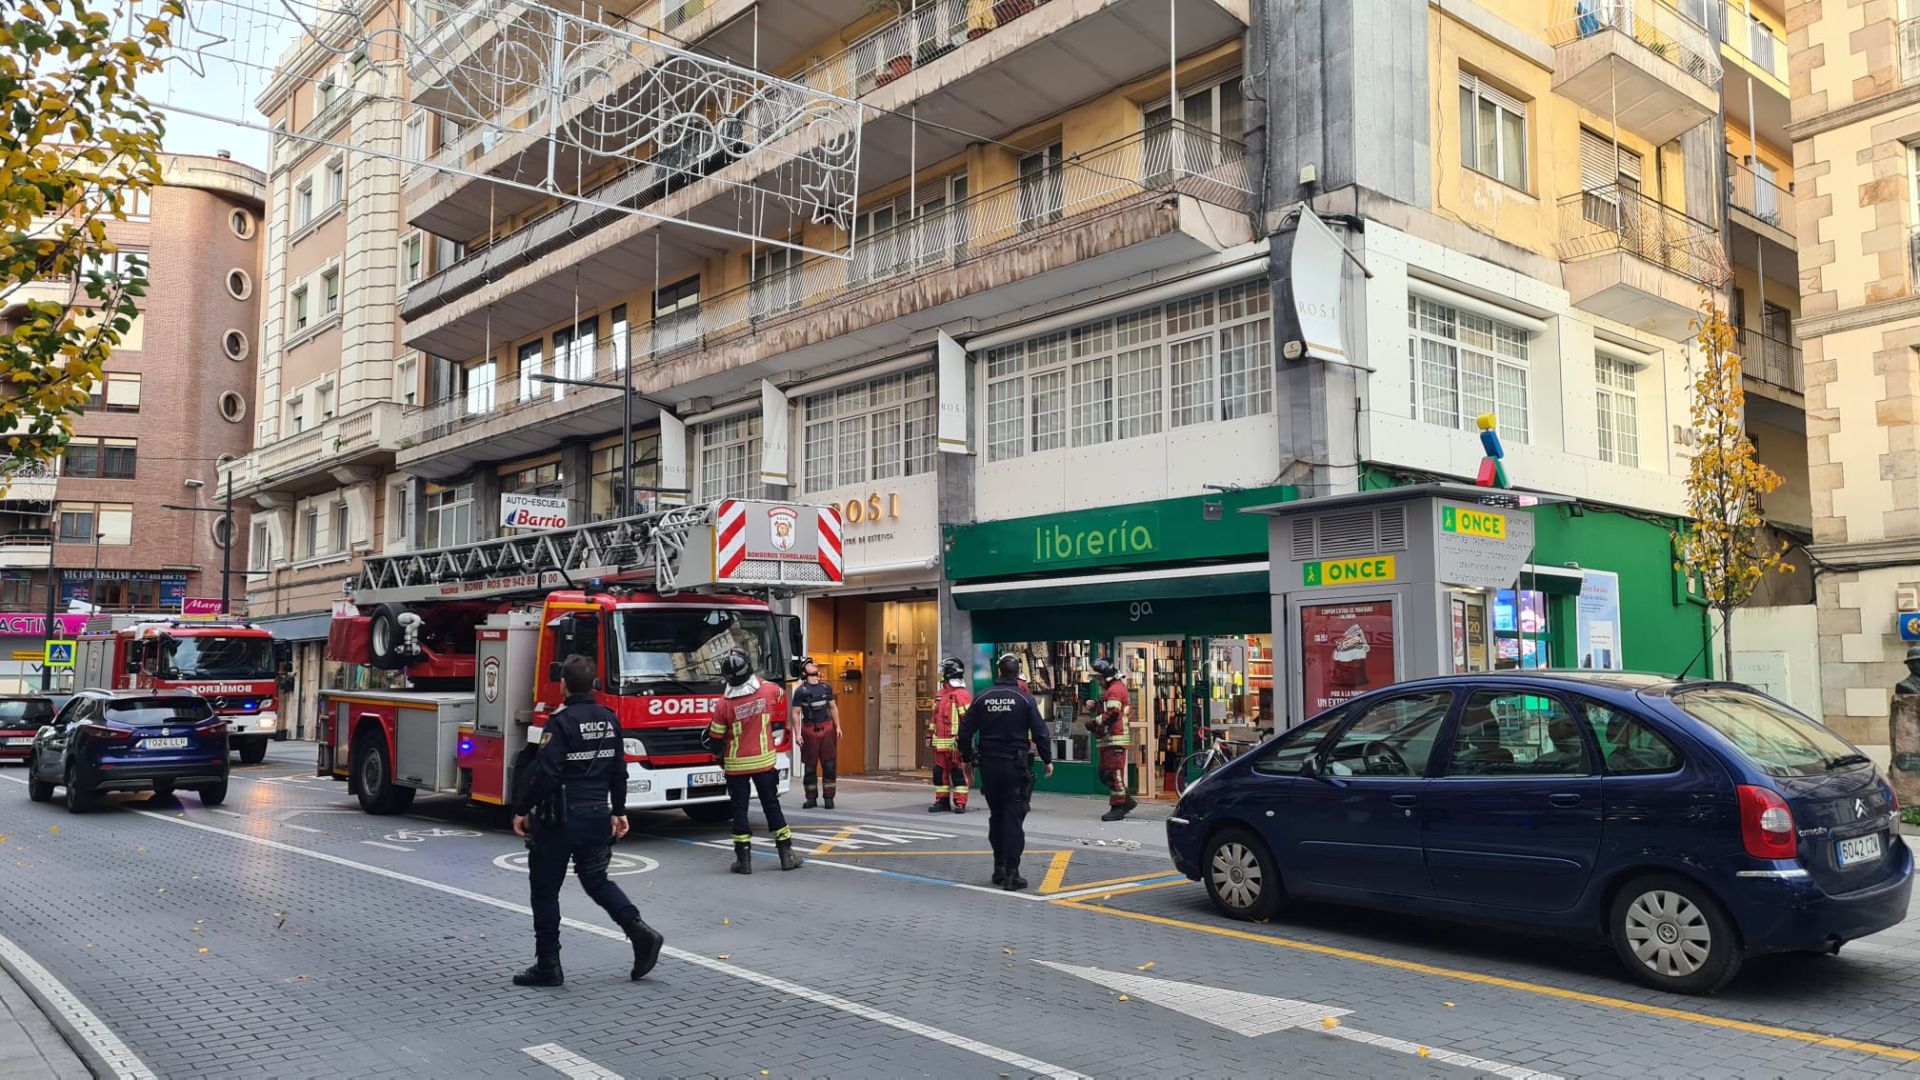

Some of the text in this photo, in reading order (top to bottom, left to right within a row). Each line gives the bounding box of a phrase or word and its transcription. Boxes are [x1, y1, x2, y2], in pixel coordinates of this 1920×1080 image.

[506, 496, 566, 509] AUTO-ESCUELA
[517, 509, 566, 529] Barrio
[1461, 513, 1500, 534] ONCE
[1036, 520, 1153, 560] librería
[548, 573, 558, 583] 00
[1329, 560, 1387, 580] ONCE
[1129, 601, 1153, 622] ga
[0, 616, 66, 633] ACTIA
[985, 698, 1016, 706] POLICIA
[694, 774, 714, 784] 4514
[1842, 840, 1864, 860] 6042
